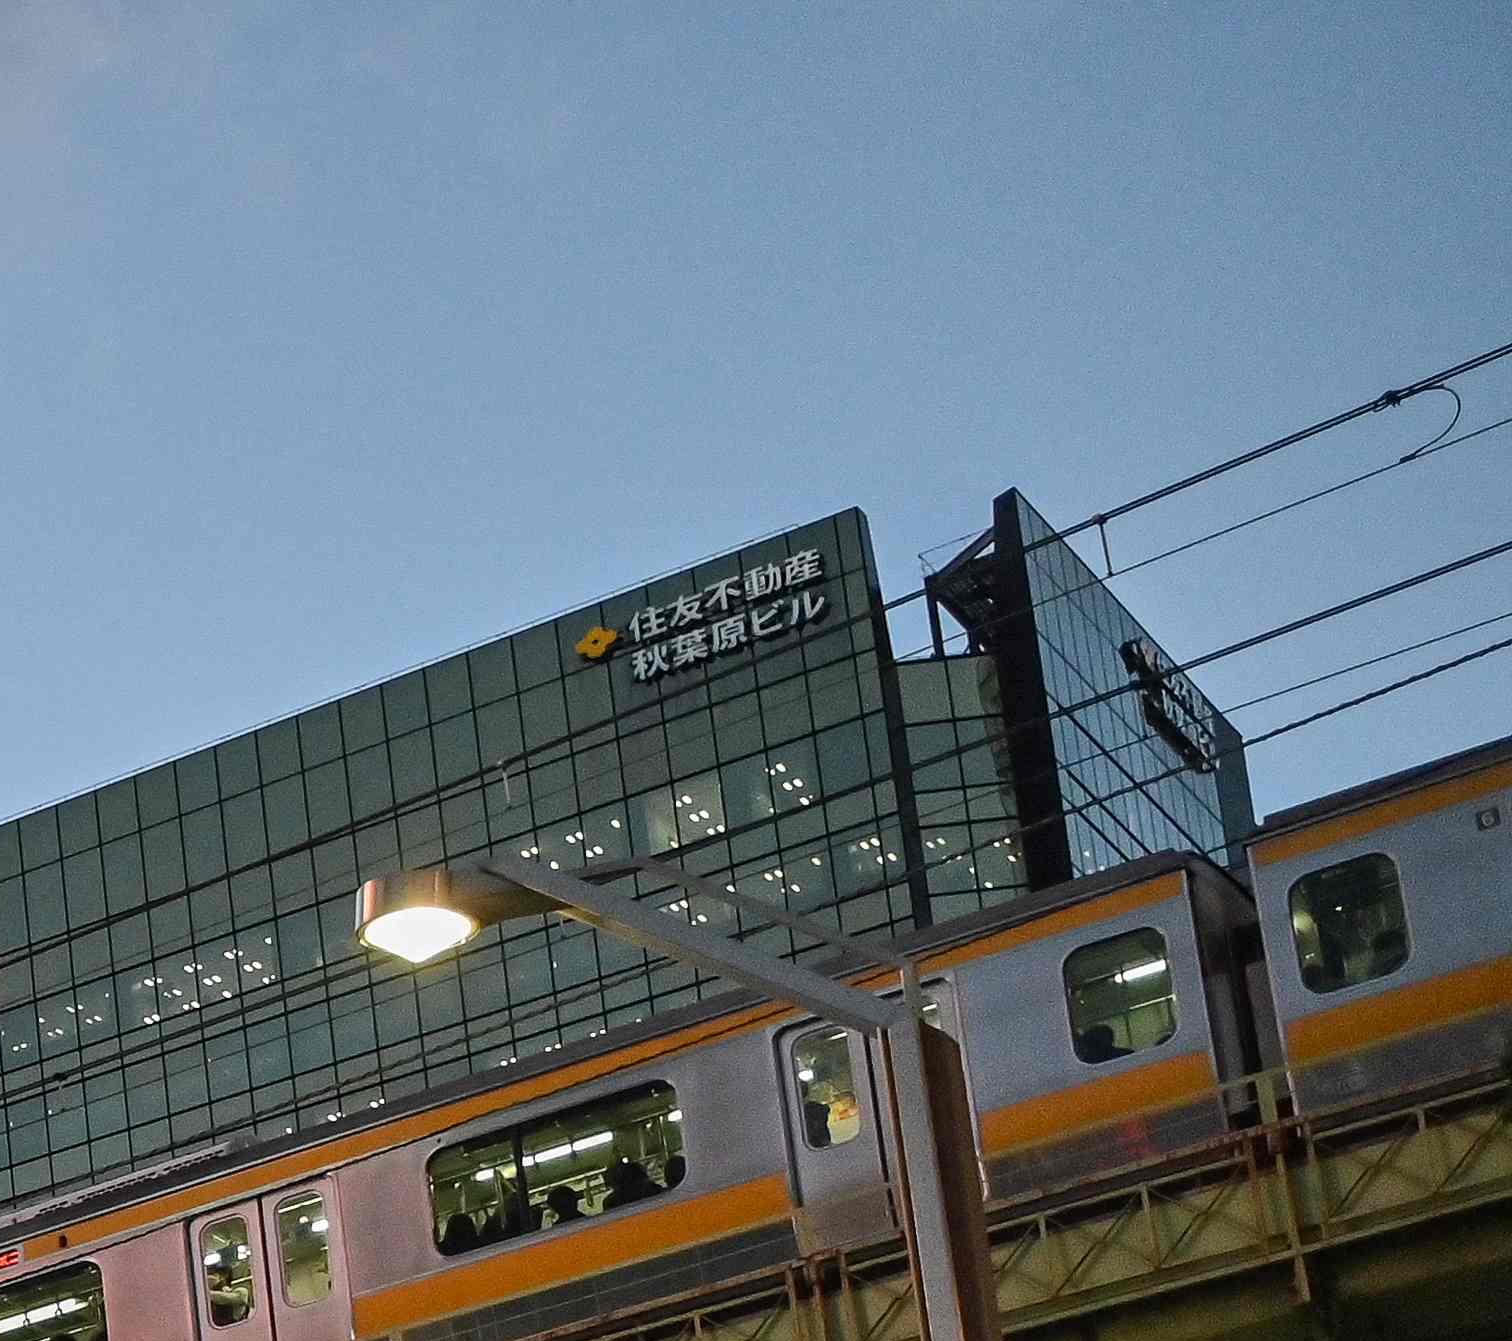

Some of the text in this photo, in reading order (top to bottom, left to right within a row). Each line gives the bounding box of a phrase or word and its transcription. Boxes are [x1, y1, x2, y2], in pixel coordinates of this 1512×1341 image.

[628, 546, 824, 641] 住友不動産
[630, 592, 827, 683] 秋葉原ビル
